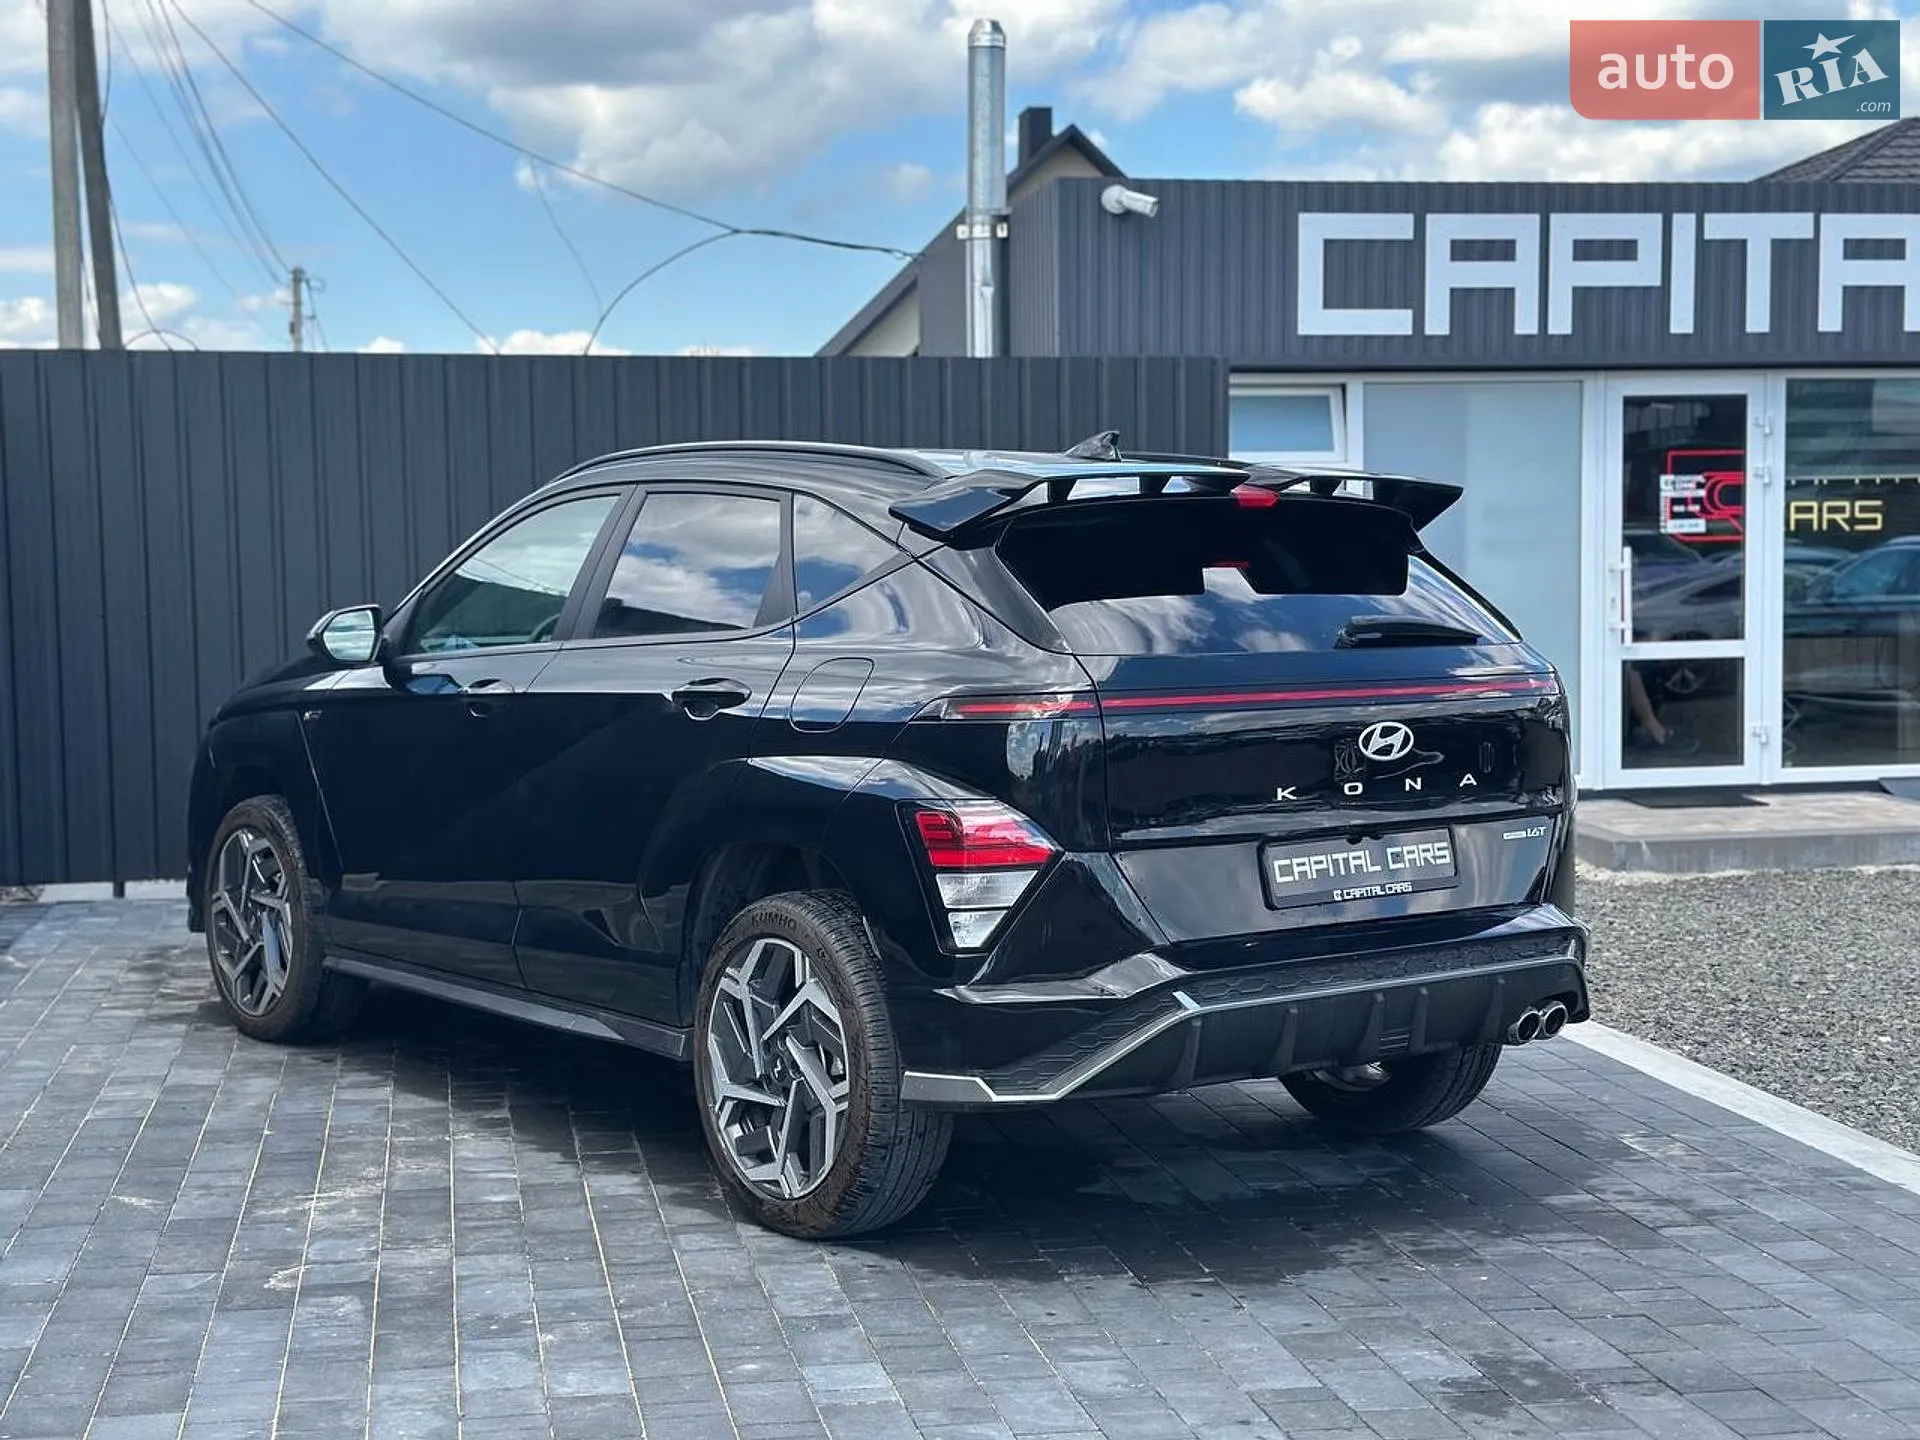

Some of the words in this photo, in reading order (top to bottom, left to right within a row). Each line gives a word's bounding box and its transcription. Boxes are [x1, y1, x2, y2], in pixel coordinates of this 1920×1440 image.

[1297, 212, 1920, 336] CAPITA
[1790, 500, 1883, 532] ARS
[1276, 773, 1477, 801] KONA
[1273, 850, 1382, 883] CAPITAL
[1386, 842, 1451, 870] CARS
[1343, 885, 1385, 900] CAPITAL
[1385, 882, 1412, 895] CARS
[751, 911, 797, 930] KUMHO
